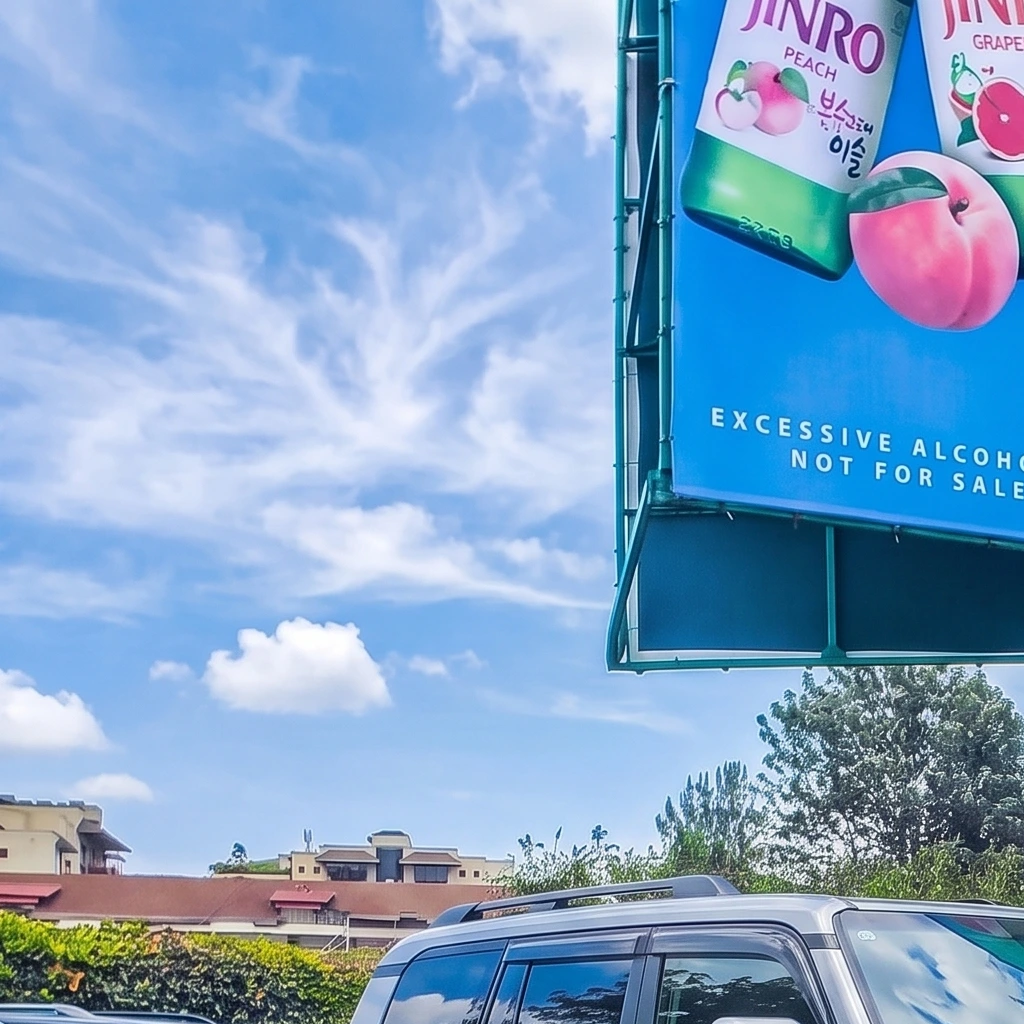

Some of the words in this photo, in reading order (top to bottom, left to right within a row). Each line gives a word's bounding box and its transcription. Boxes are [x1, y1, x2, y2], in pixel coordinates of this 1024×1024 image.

[784, 46, 838, 82] PEACH
[829, 135, 866, 179] 이슬
[711, 407, 892, 453] EXCESSIVE
[791, 449, 853, 476] NOT
[875, 461, 933, 487] FOR
[953, 472, 1024, 501] SALE
